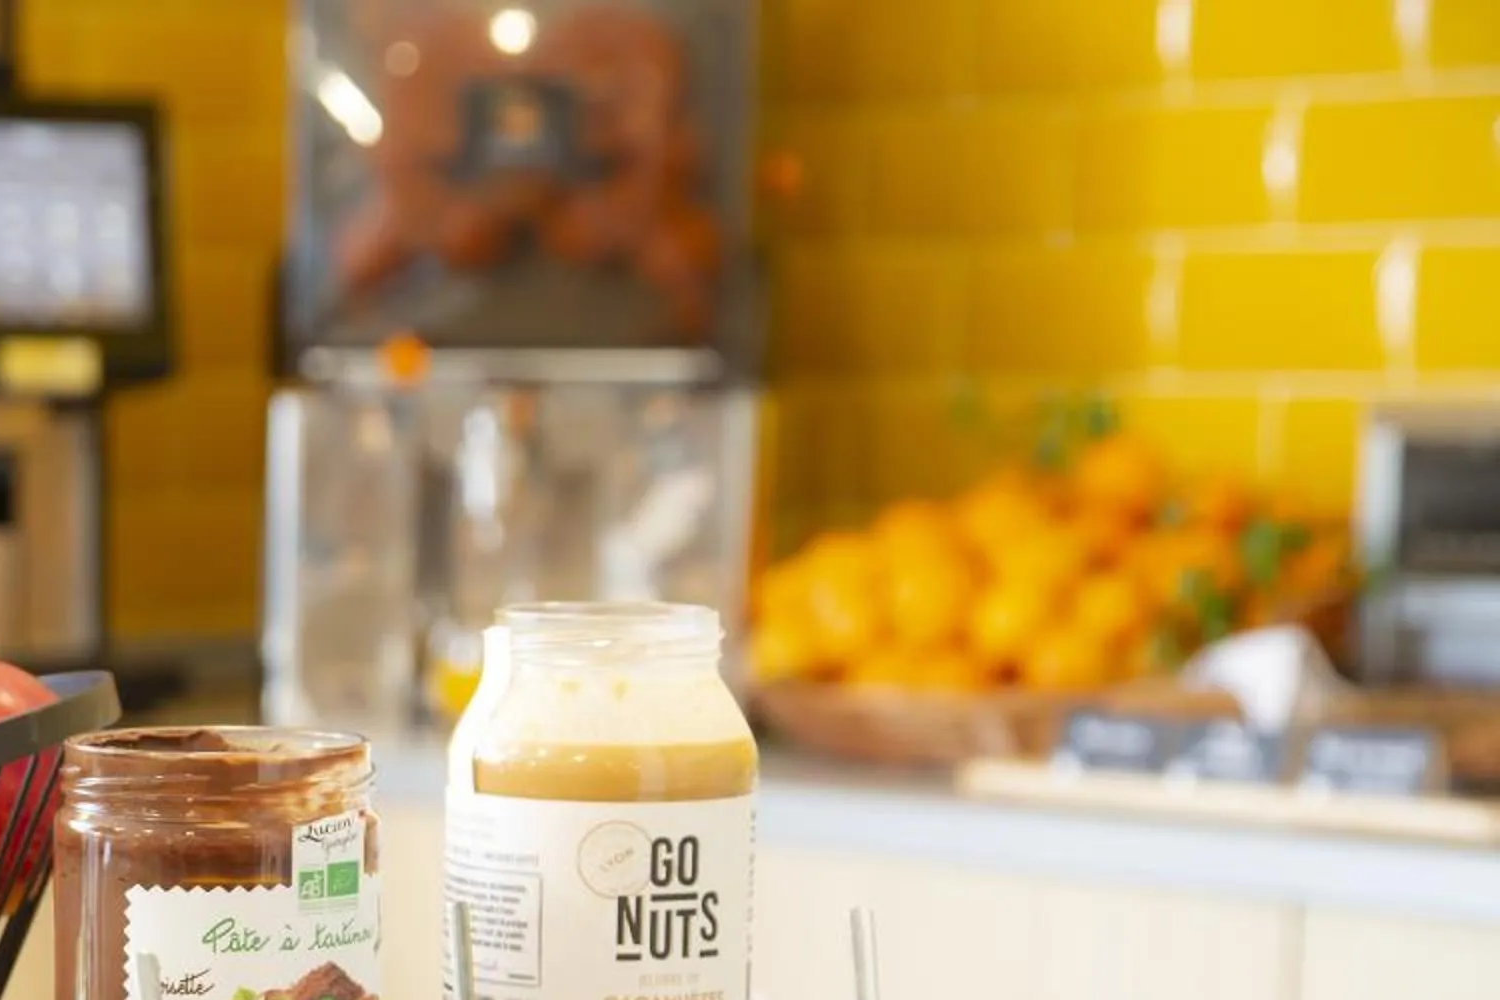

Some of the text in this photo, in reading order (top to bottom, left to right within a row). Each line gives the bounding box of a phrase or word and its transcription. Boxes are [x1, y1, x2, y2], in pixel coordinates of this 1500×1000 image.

[298, 818, 353, 842] Lucien
[650, 835, 699, 886] GO
[202, 917, 270, 953] Pâte
[279, 924, 301, 951] à
[617, 891, 719, 960] NUTS
